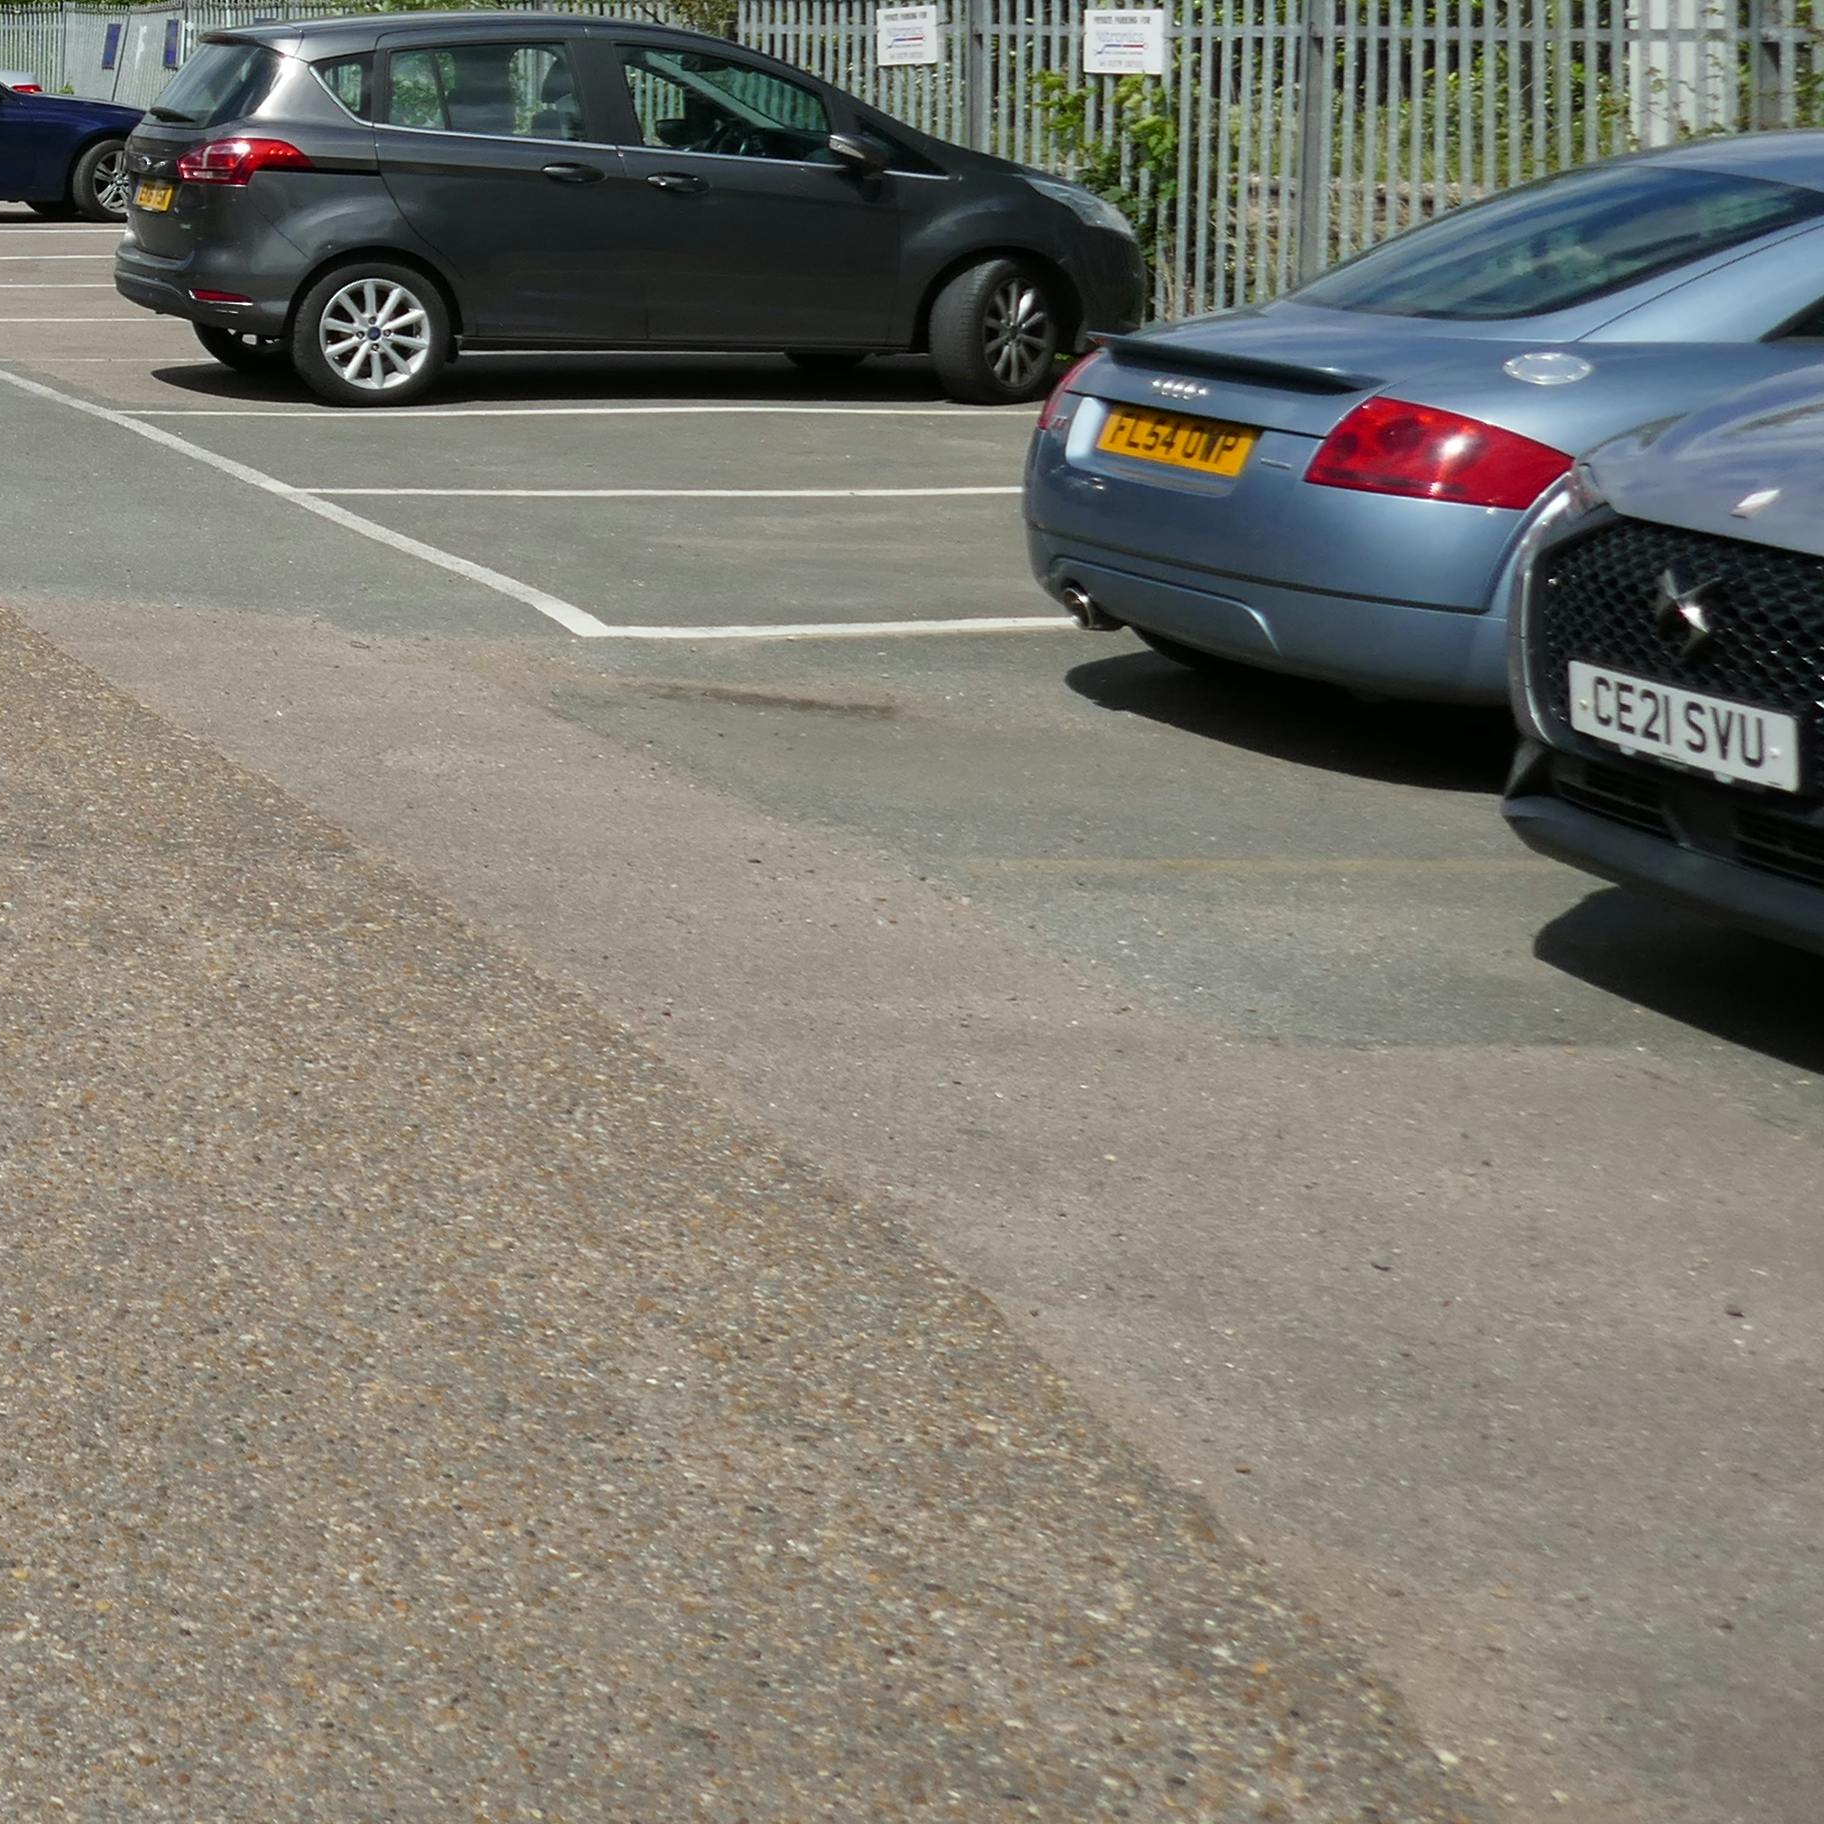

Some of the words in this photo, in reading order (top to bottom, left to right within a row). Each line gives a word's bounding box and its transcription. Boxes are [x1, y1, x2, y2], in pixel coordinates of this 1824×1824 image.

[1109, 412, 1177, 455] FL54
[1593, 676, 1673, 745] CE21
[1684, 701, 1765, 768] SVU
